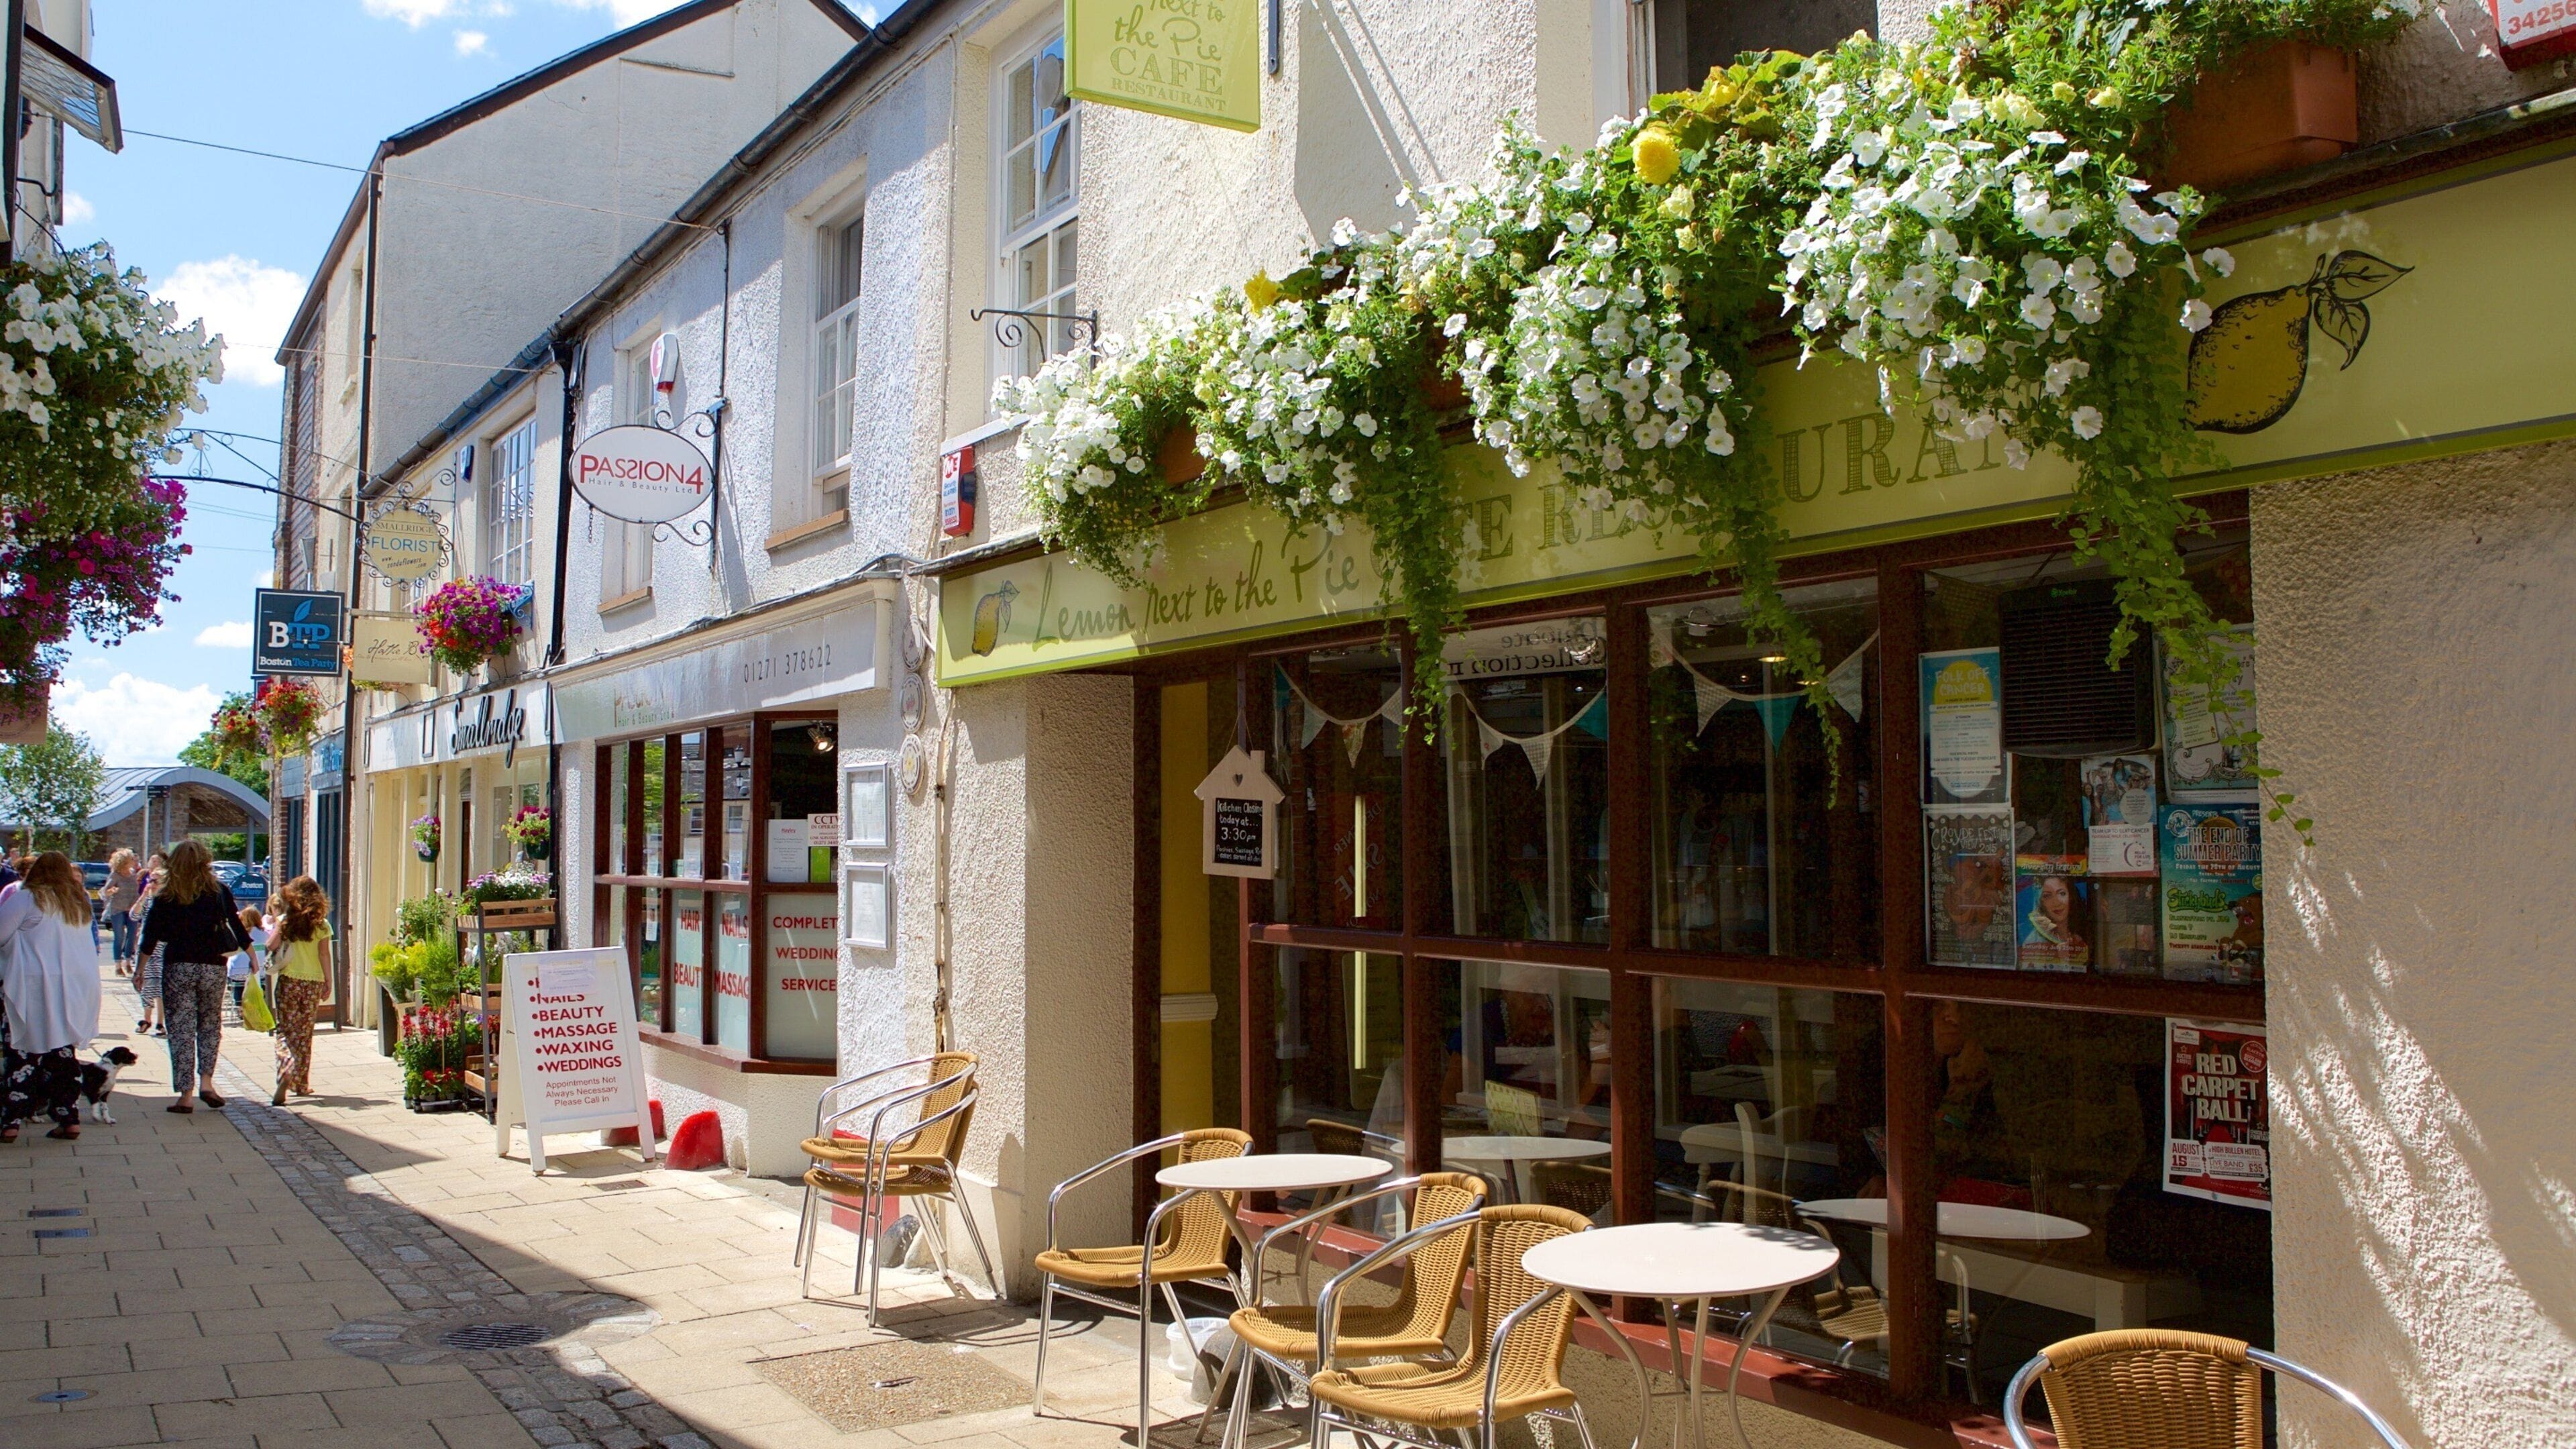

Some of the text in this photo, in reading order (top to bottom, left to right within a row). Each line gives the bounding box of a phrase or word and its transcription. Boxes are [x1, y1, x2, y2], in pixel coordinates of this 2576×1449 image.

[1208, 1, 1226, 22] to
[1114, 4, 1222, 61] the Pie
[1110, 47, 1223, 95] CAFE
[1111, 77, 1226, 112] RESTAURANT
[589, 478, 612, 486] Hair
[633, 482, 669, 493] Beauty
[376, 521, 433, 534] SMALLRIDGE
[372, 536, 439, 553] FLORIST
[1032, 561, 1136, 652] Lemon
[1205, 576, 1227, 617] to
[1234, 540, 1277, 612] the
[1281, 520, 1360, 603] Pie
[268, 621, 330, 649] BTP
[260, 656, 336, 670] Boston Tea Party
[744, 643, 831, 683] 01271 378622
[1935, 666, 1990, 683] FOLK OFF
[1939, 683, 1987, 696] CANCER
[451, 689, 525, 768] Smallridge
[1219, 813, 1240, 826] today
[2187, 826, 2250, 843] THE END OF
[1979, 843, 1997, 854] 2015
[2174, 844, 2261, 861] SUMMER PARTY
[681, 908, 700, 932] HAIR
[722, 913, 749, 938] NAILS
[773, 916, 839, 929] COMPLET
[782, 979, 837, 991] SERVICE
[539, 1006, 604, 1022] BEAUTY
[541, 1022, 618, 1038] MASSAGE
[543, 1040, 614, 1055] WAXING
[544, 1056, 622, 1073] WEDDINGS
[2196, 1053, 2237, 1075] RED
[545, 1077, 600, 1089] Appointments
[2181, 1074, 2259, 1100] CARPET
[545, 1085, 618, 1098] Always Necessary
[555, 1097, 582, 1107] Please
[2196, 1097, 2247, 1123] BALL
[2172, 1142, 2200, 1155] AUGUST
[2225, 1146, 2244, 1155] BULLEN
[2244, 1148, 2261, 1156] HOTEL
[2172, 1155, 2188, 1167] 15
[2249, 1163, 2263, 1173] £35
